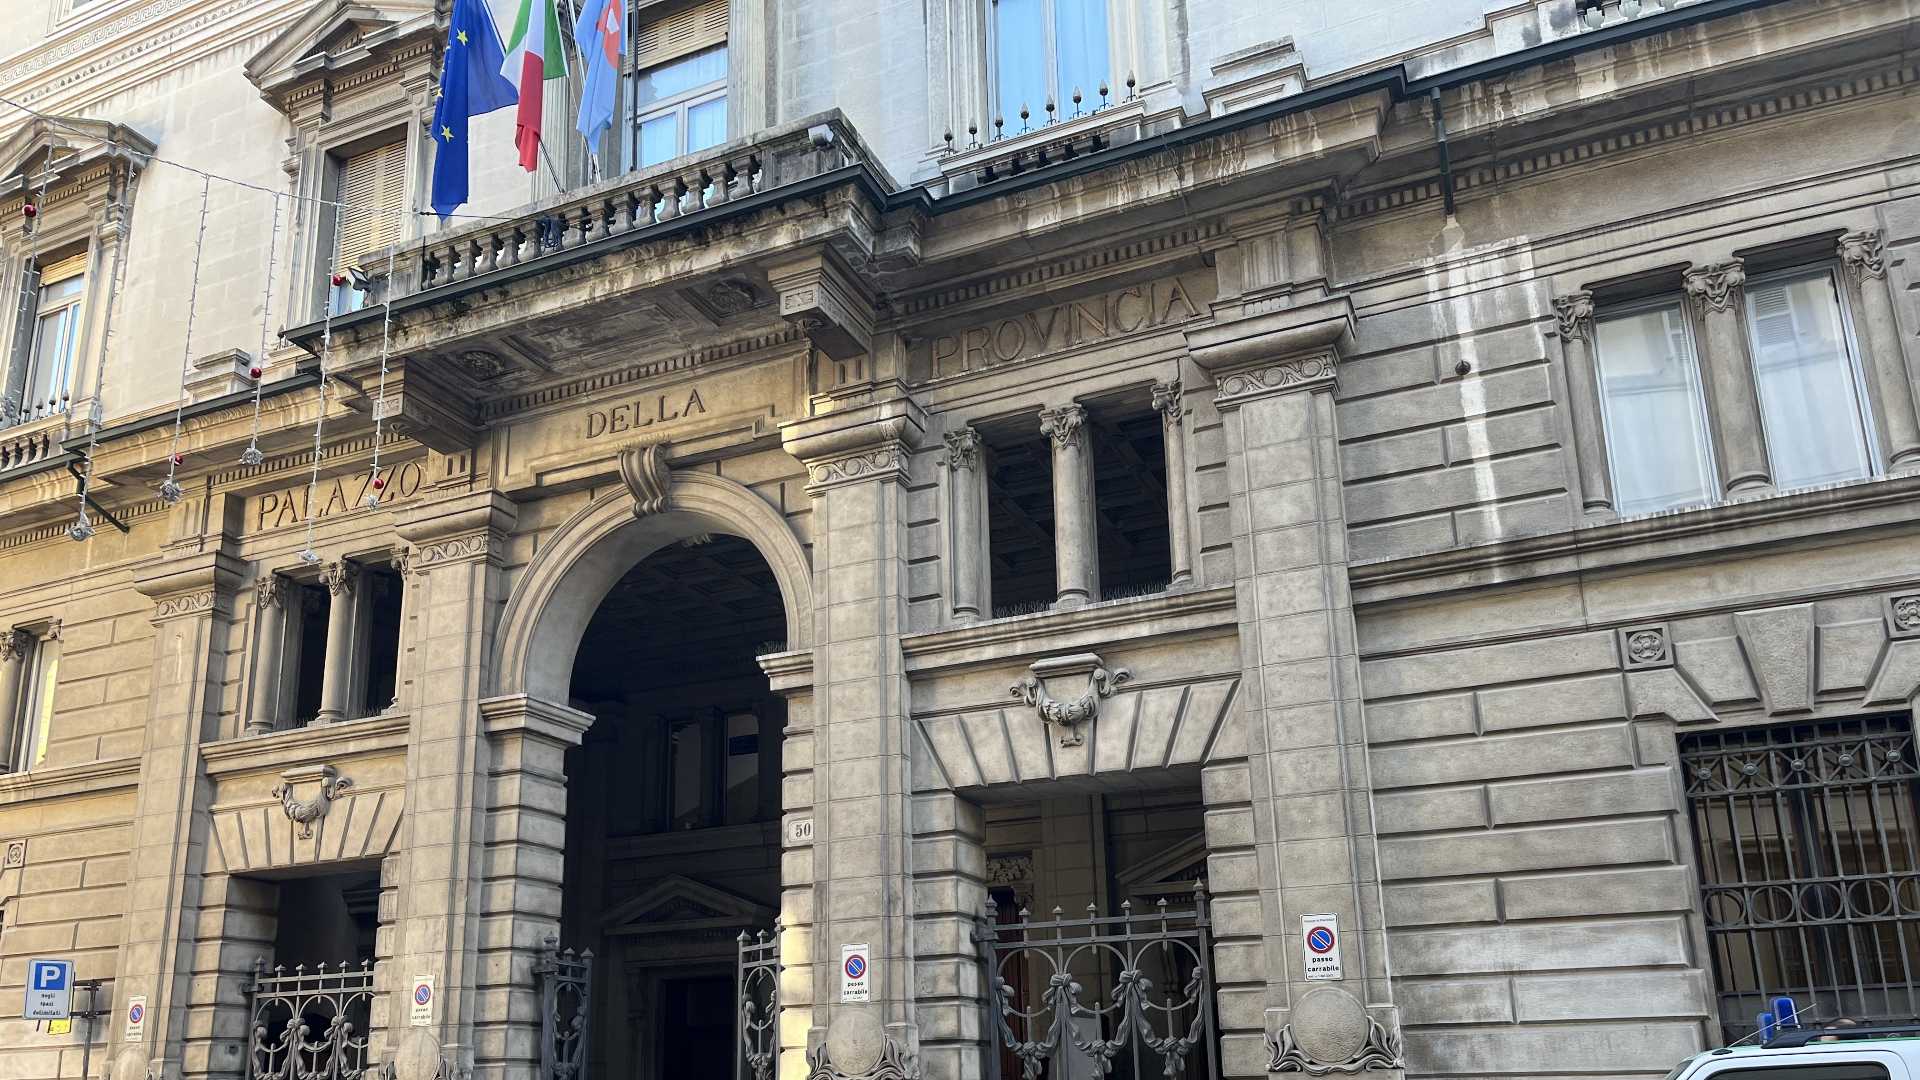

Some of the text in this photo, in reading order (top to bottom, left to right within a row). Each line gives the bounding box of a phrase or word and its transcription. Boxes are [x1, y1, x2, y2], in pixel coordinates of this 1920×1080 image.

[257, 277, 1200, 531] PALAZZO DELLA PROVINCIA
[796, 822, 811, 838] 50
[40, 965, 61, 988] P
